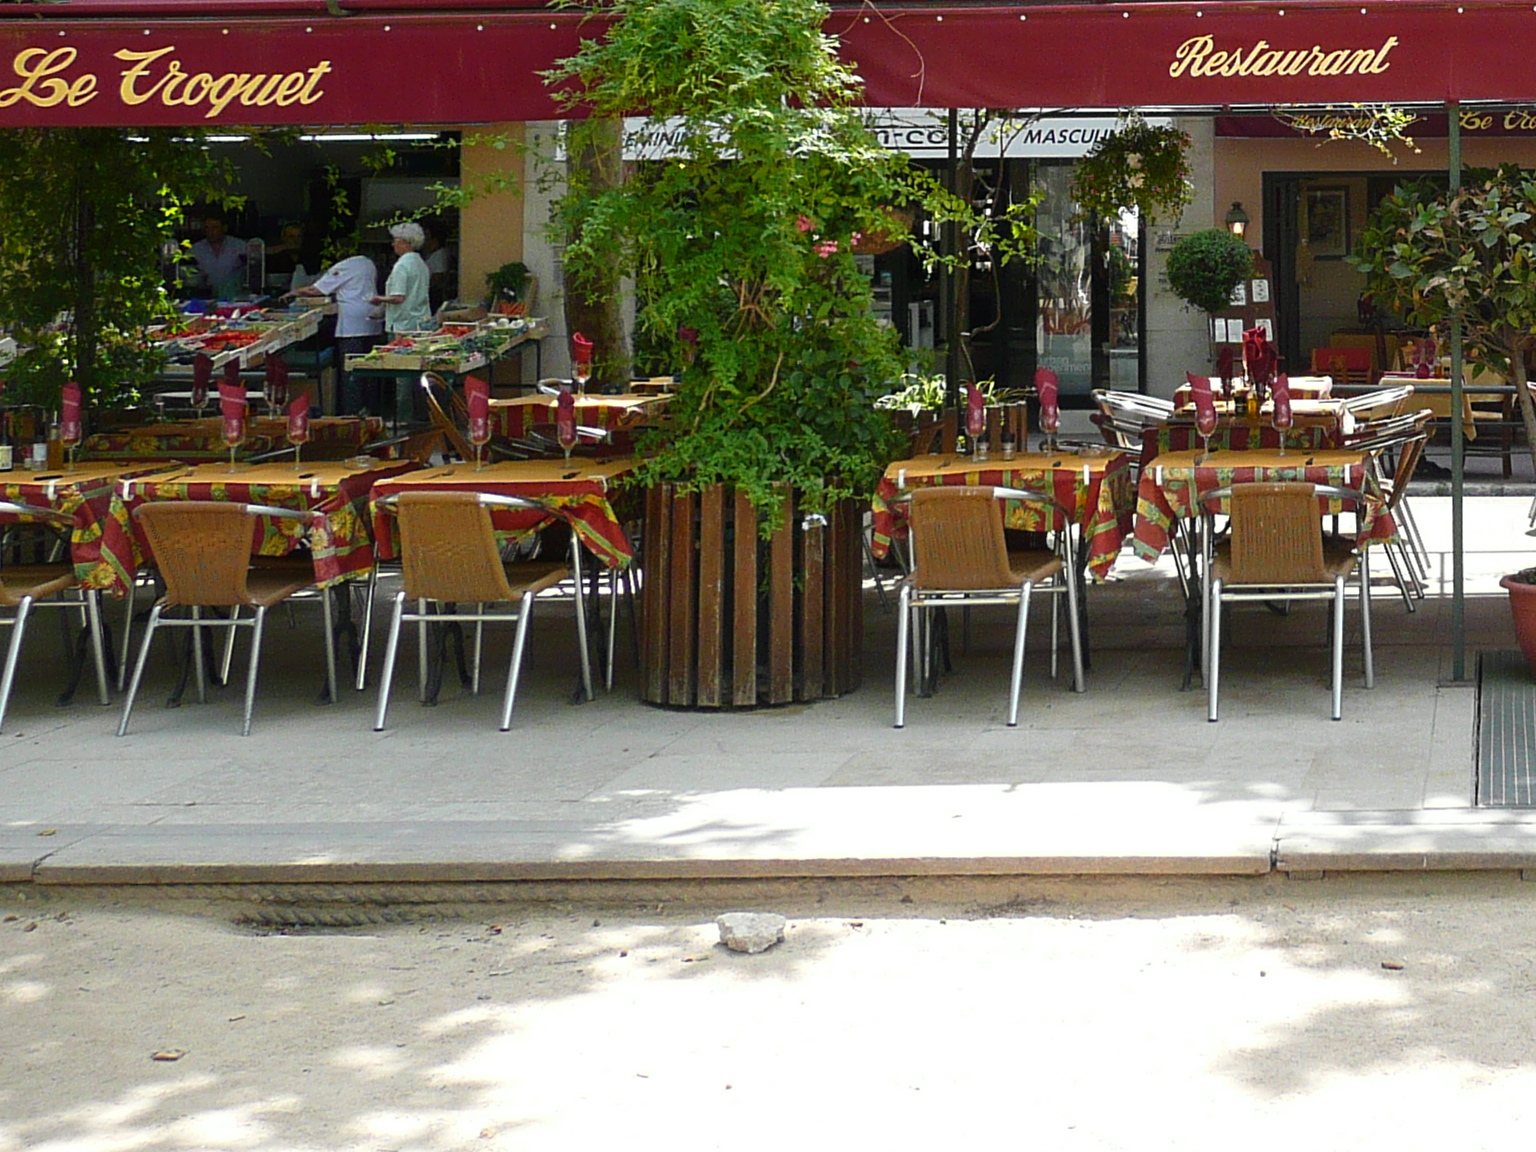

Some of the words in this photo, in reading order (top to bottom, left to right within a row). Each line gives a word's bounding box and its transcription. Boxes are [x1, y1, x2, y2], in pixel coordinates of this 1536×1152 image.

[1169, 34, 1399, 78] Restaurant
[0, 47, 99, 108] Le
[113, 46, 332, 118] Troquet
[1291, 113, 1382, 130] Restauran
[1459, 110, 1493, 130] Le
